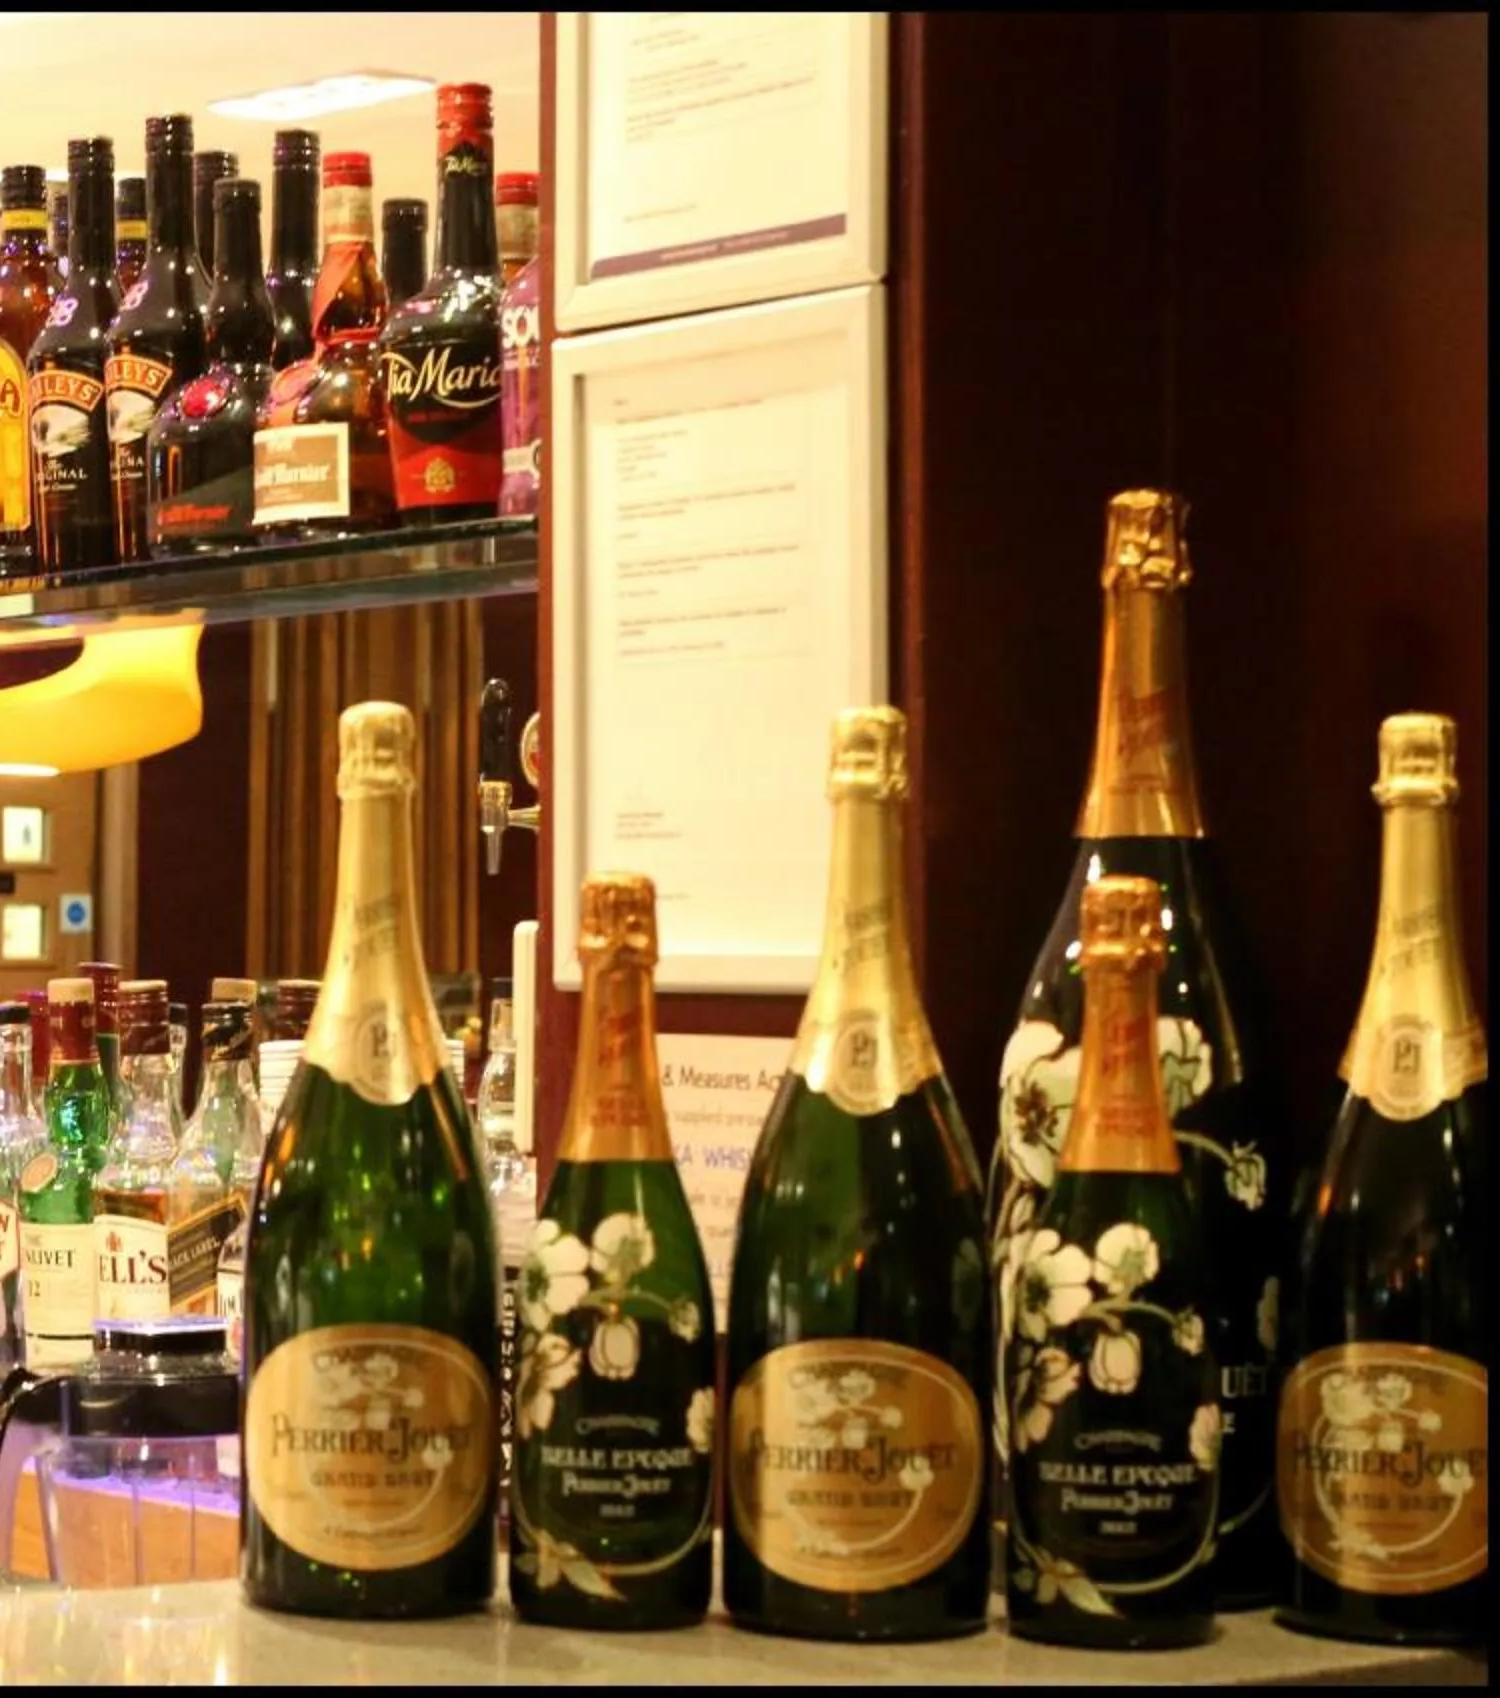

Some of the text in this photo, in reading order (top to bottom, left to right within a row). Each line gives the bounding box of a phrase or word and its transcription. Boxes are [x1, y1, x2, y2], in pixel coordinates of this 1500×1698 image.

[380, 351, 418, 401] Tia
[679, 1065, 752, 1092] Measures
[100, 1250, 167, 1284] ELL'S
